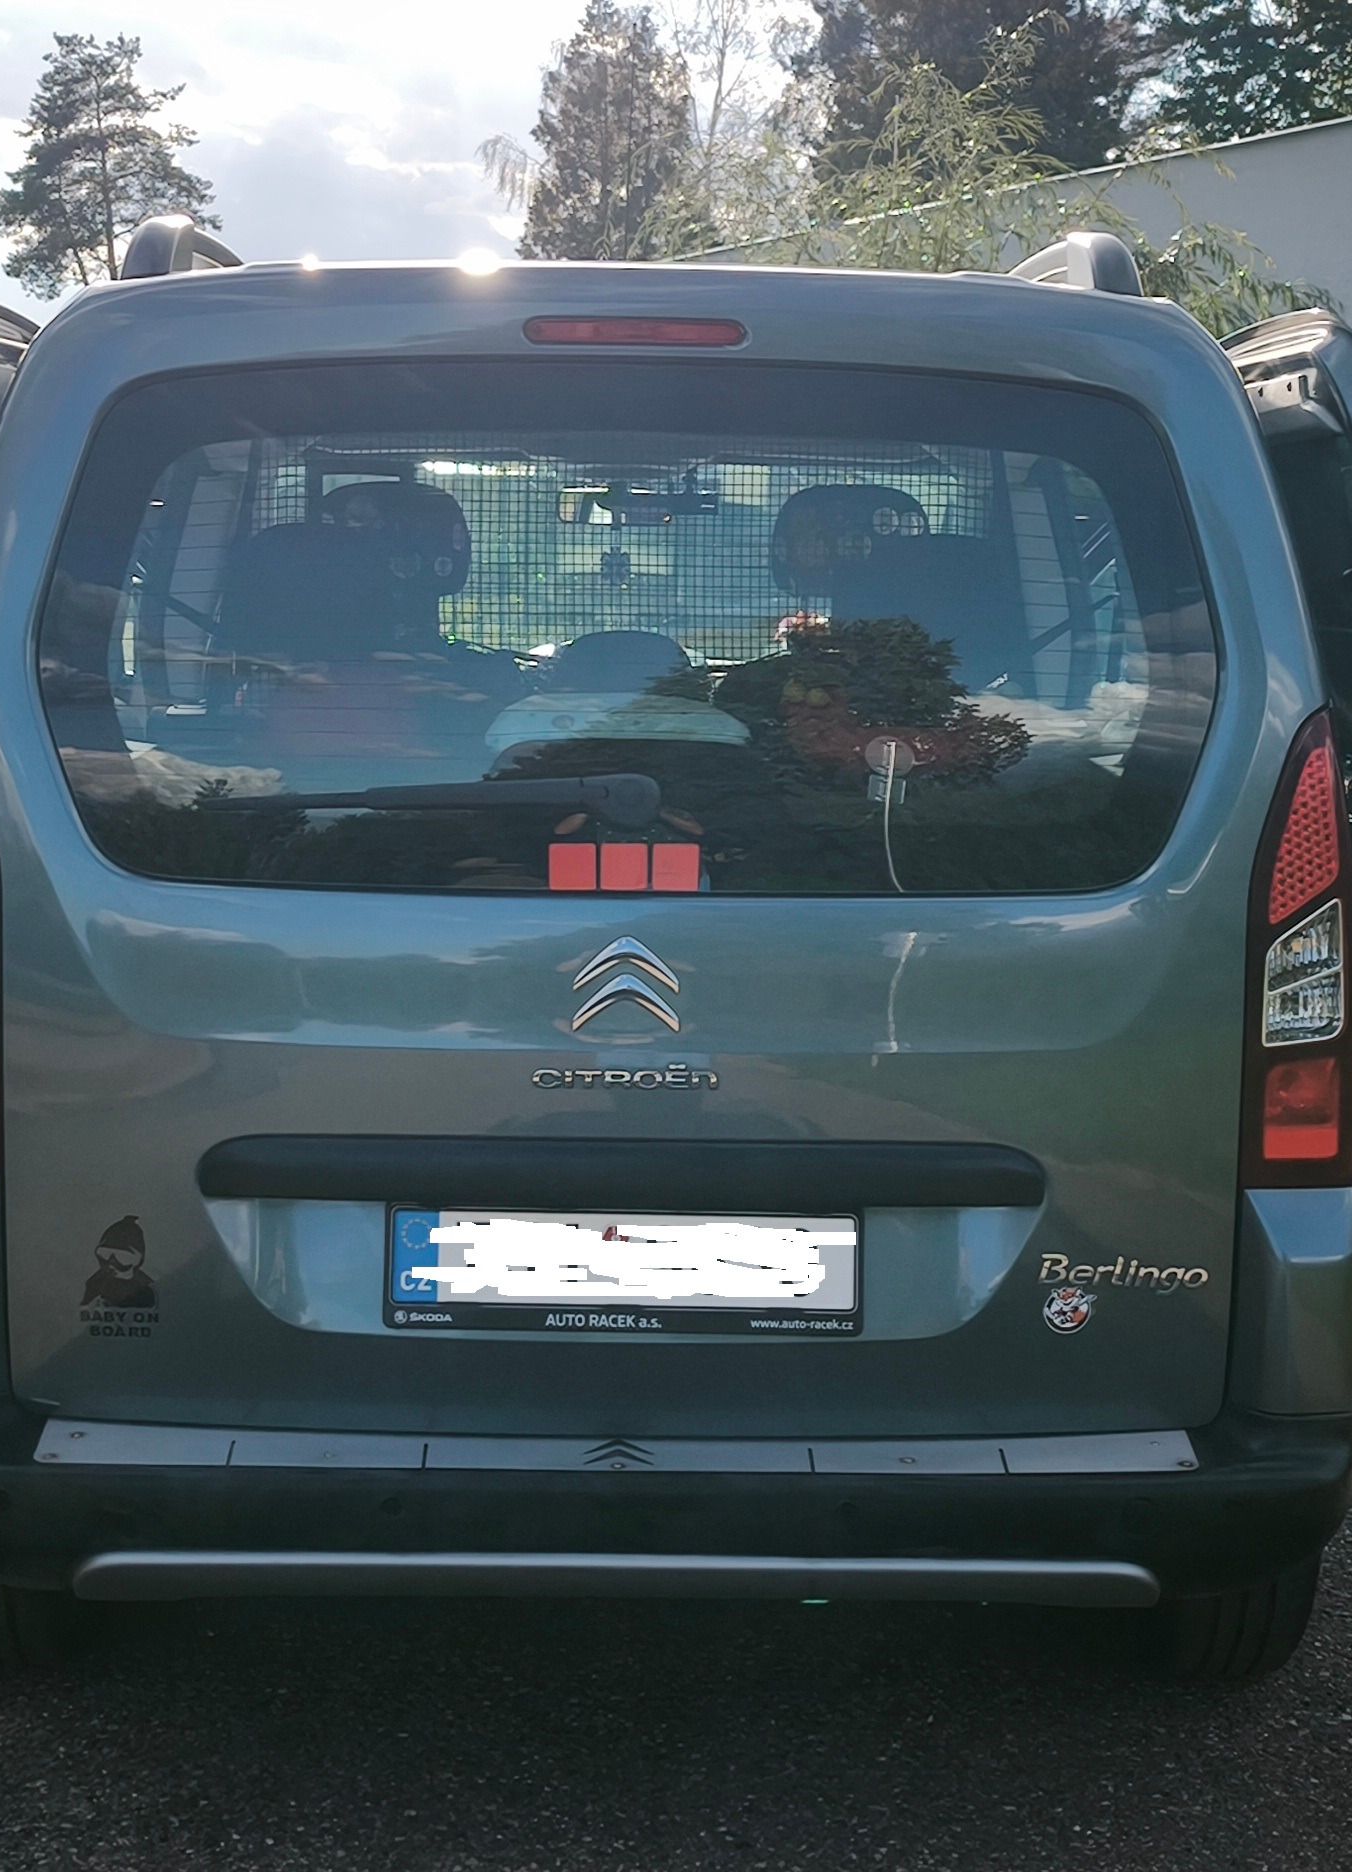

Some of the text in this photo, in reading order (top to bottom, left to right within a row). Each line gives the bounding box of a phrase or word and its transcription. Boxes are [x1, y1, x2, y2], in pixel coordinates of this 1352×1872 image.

[399, 1270, 433, 1291] CZ
[1037, 1252, 1210, 1297] Berlingo
[79, 1310, 160, 1324] BABY ON
[545, 1313, 662, 1329] AUTO RACEK a.s.
[88, 1325, 152, 1338] BOARD
[750, 1319, 854, 1331] www.auto-racek.cz
